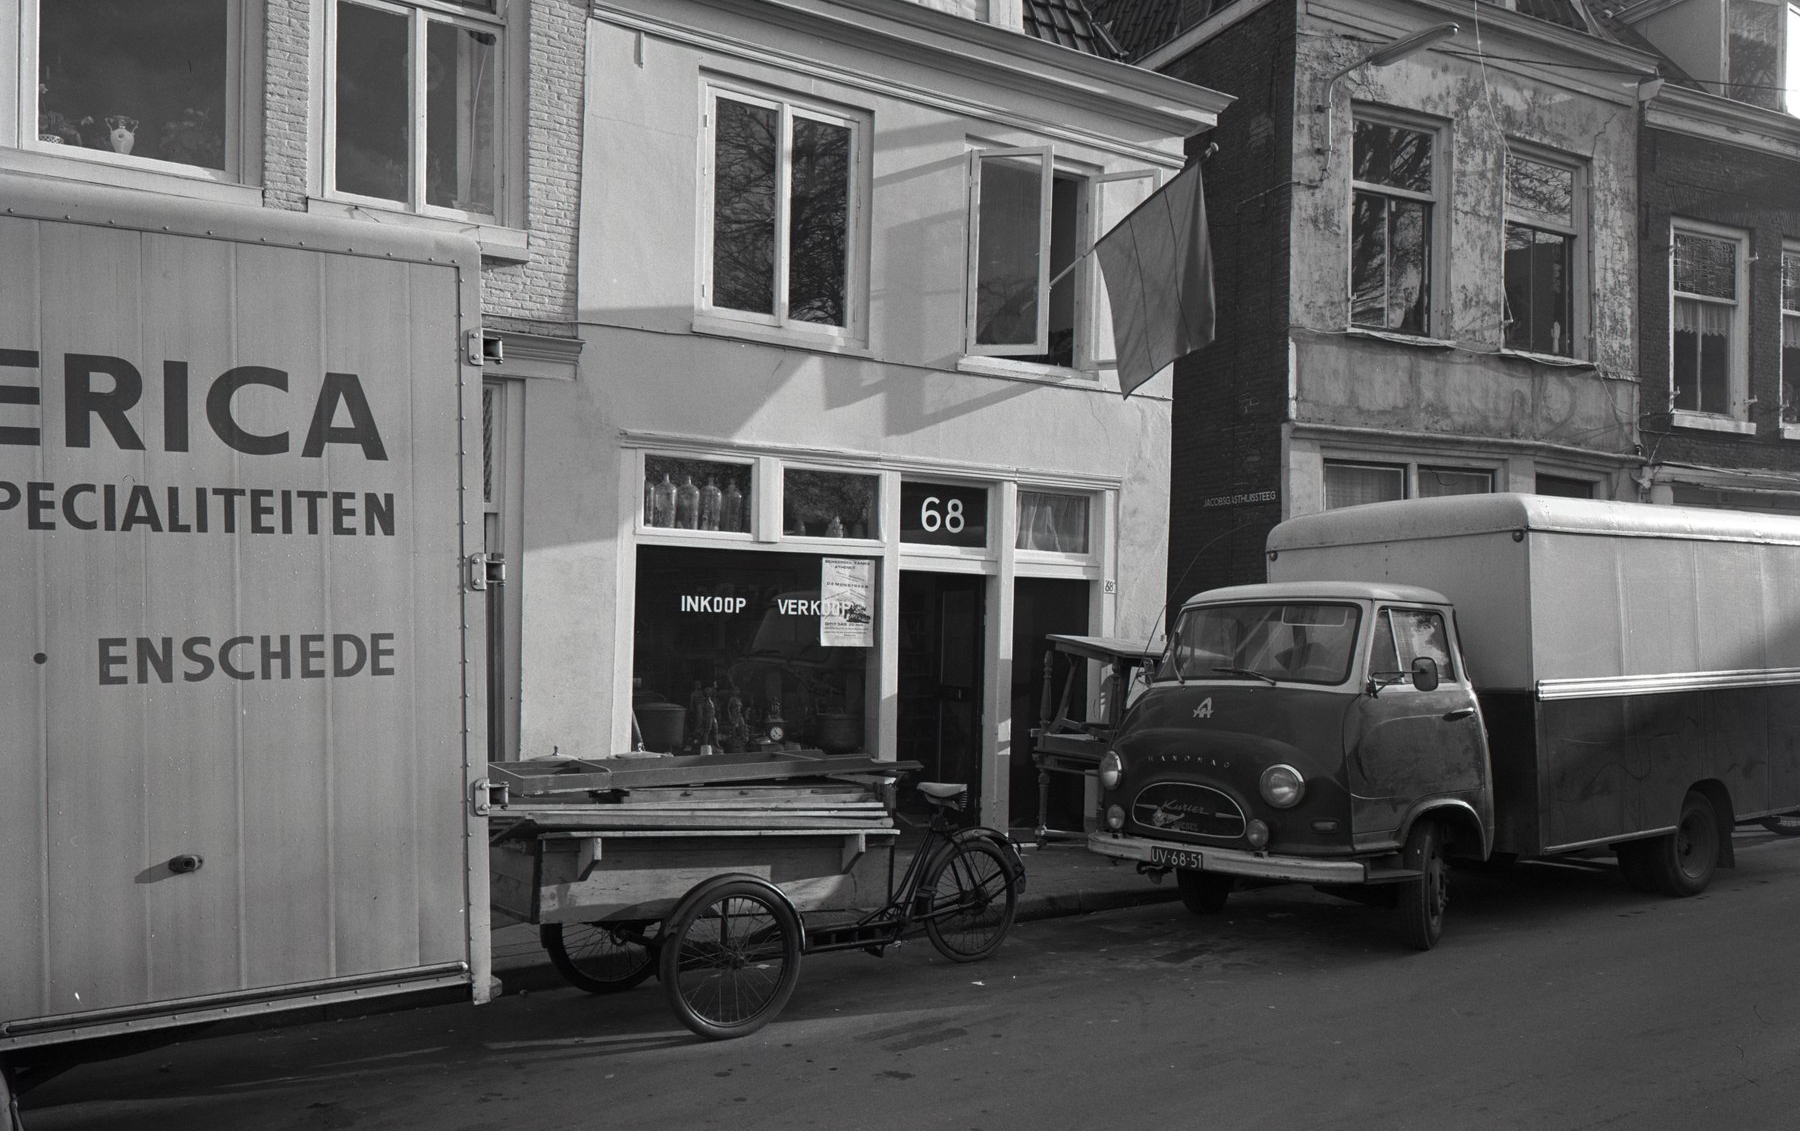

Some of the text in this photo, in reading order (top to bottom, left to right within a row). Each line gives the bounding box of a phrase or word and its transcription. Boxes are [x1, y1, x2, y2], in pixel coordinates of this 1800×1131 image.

[0, 348, 389, 461] ERICA
[920, 496, 965, 533] 68
[1104, 579, 1113, 592] 68
[681, 594, 851, 618] INKOOP VERKOOP
[98, 633, 395, 686] ENSCHEDE
